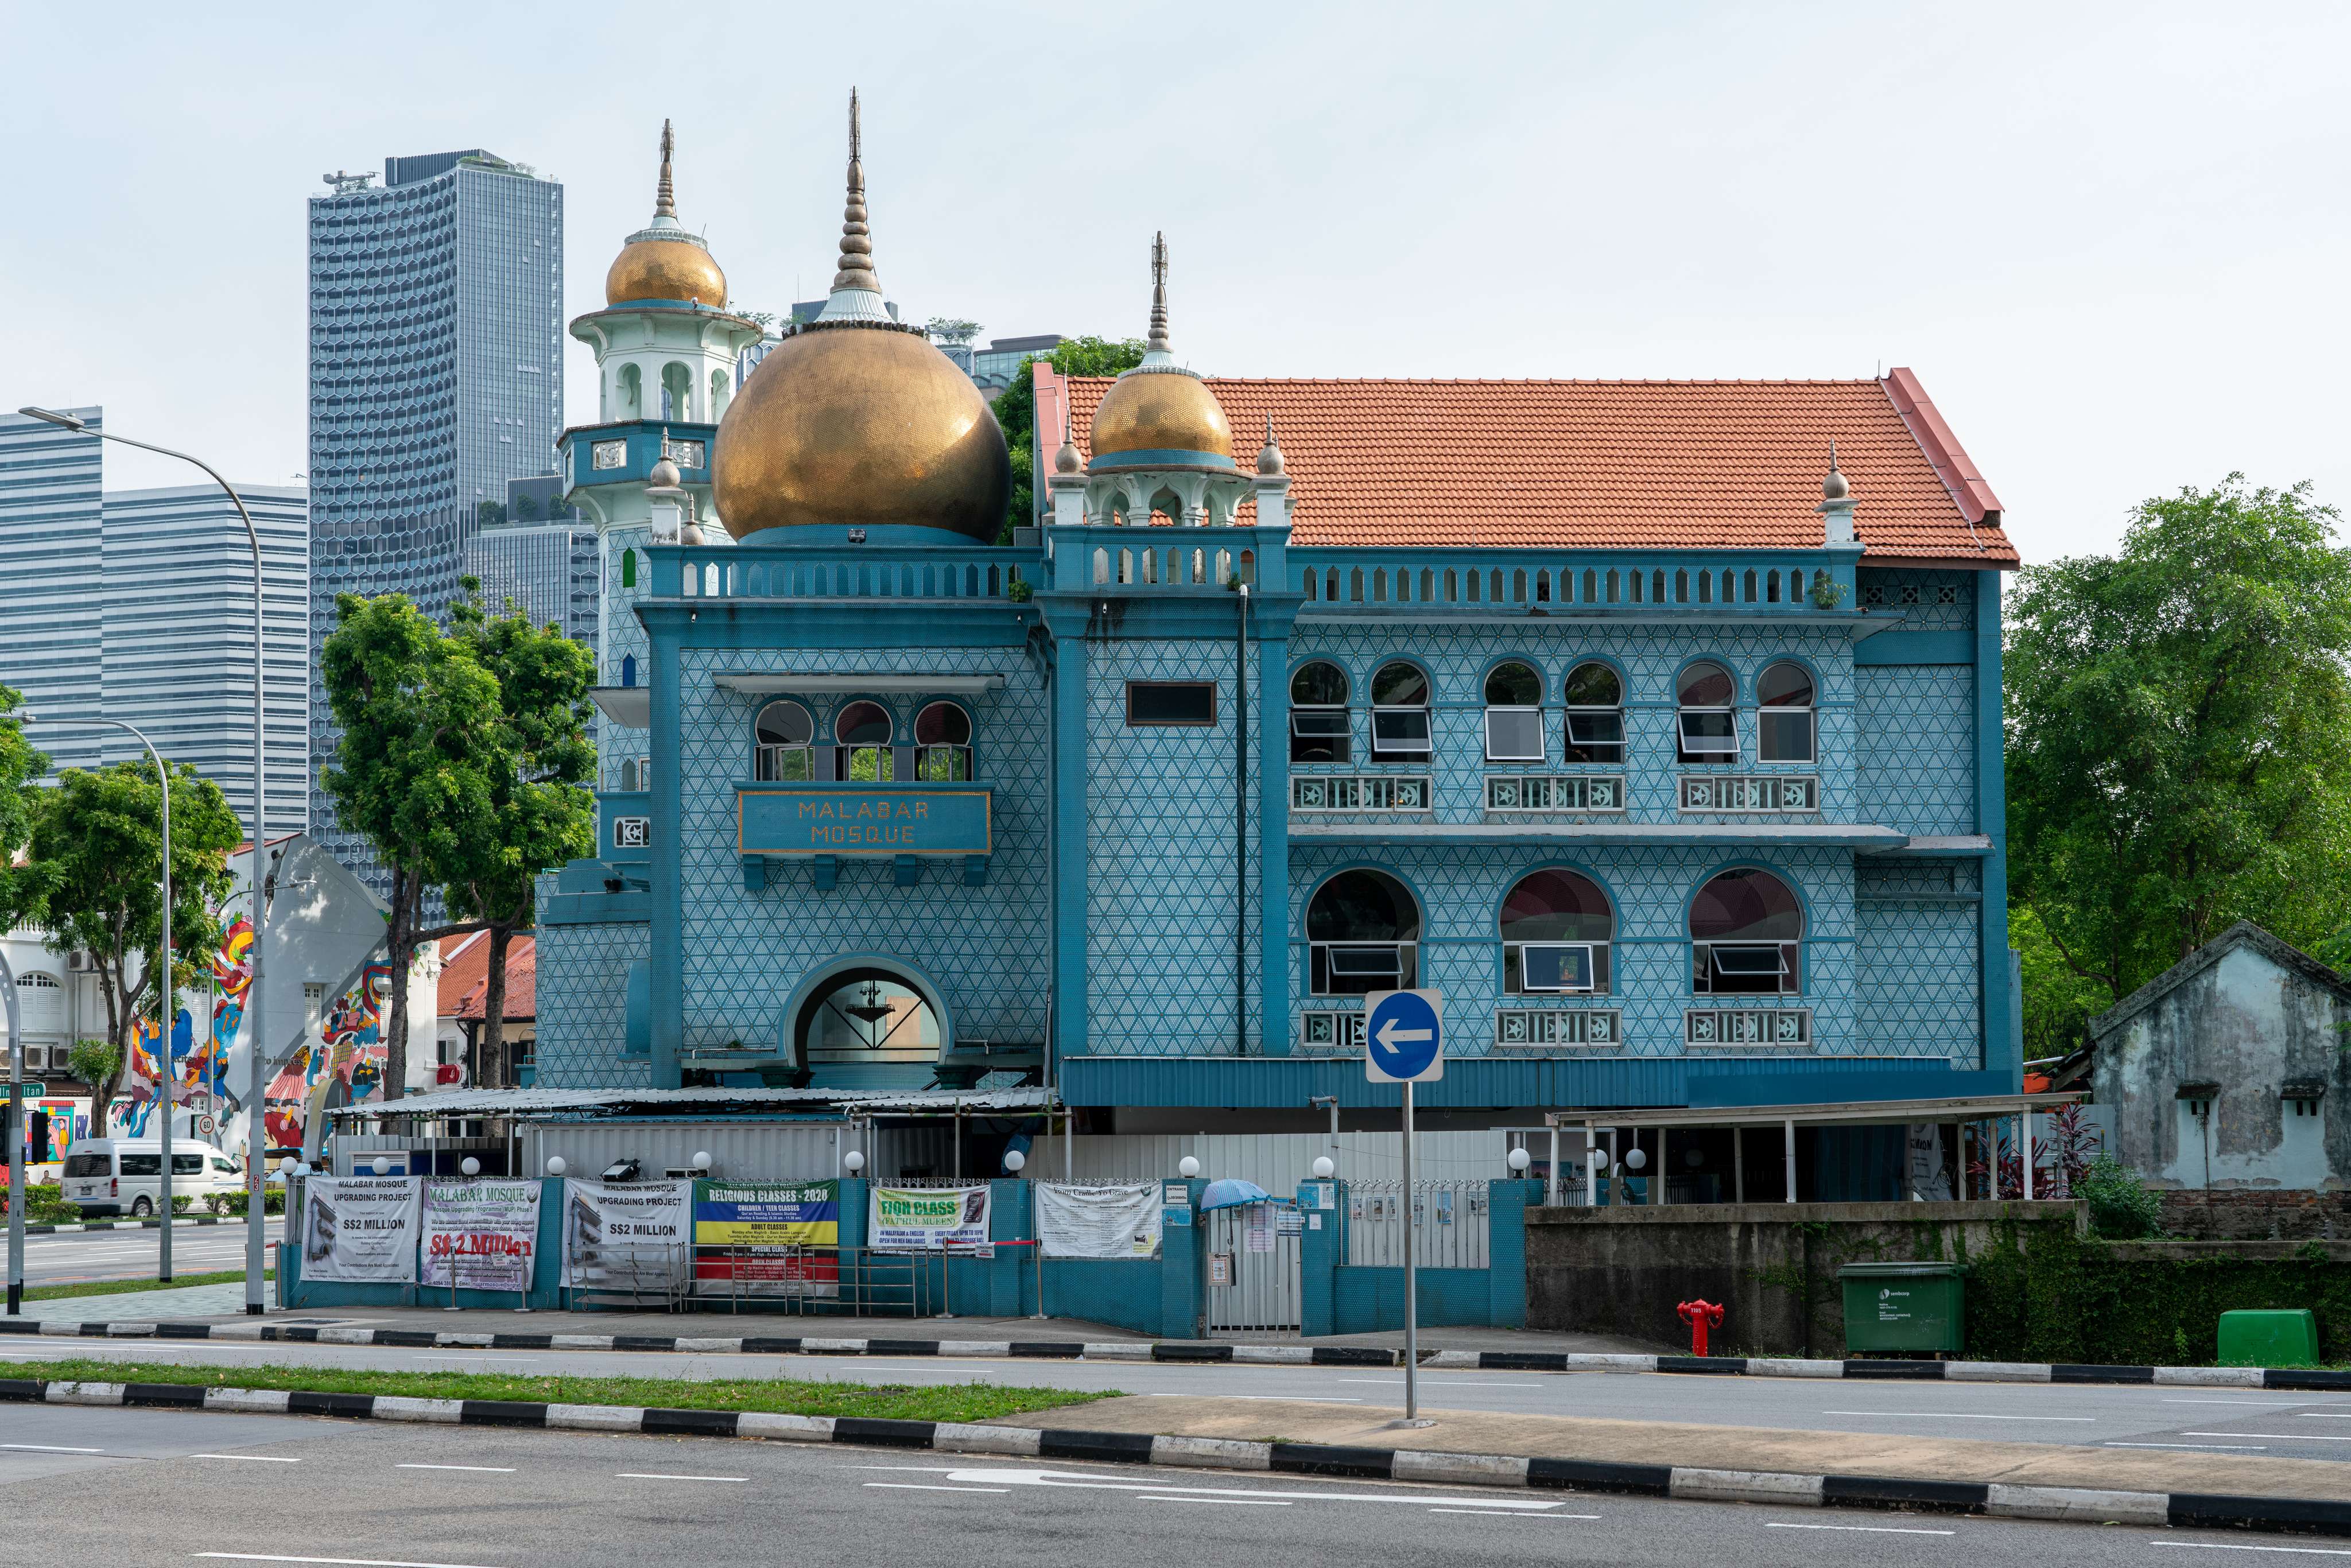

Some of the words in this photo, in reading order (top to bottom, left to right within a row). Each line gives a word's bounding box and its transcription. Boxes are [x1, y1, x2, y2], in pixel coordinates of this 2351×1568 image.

[798, 802, 928, 818] MALABAR
[811, 826, 914, 843] MOSQUE
[24, 1086, 40, 1096] ltan
[203, 1121, 211, 1129] 60
[338, 1180, 373, 1188] MALABAR
[375, 1180, 408, 1188] MOSQUE
[334, 1193, 376, 1202] UPGRADING
[378, 1193, 412, 1202] PROJECT
[429, 1187, 482, 1202] MALABAR
[486, 1187, 525, 1203] MOSQUE
[709, 1189, 755, 1202] RELIGIOUS
[758, 1190, 796, 1202] CLASSES
[804, 1189, 828, 1202] 2020
[1053, 1187, 1071, 1196] From
[597, 1197, 644, 1206] UPGRADING
[646, 1198, 682, 1206] PROJECT
[881, 1201, 911, 1216] FIQH
[914, 1201, 956, 1216] CLASS
[343, 1219, 362, 1231] S$2
[364, 1219, 405, 1229] MILLION
[882, 1217, 921, 1225] (FAT'HUL
[921, 1217, 956, 1225] MUEEN)
[610, 1224, 630, 1236] S$2
[634, 1225, 676, 1236] MILLION
[430, 1233, 451, 1257] S$
[455, 1235, 465, 1254] 2
[470, 1235, 532, 1256] Million
